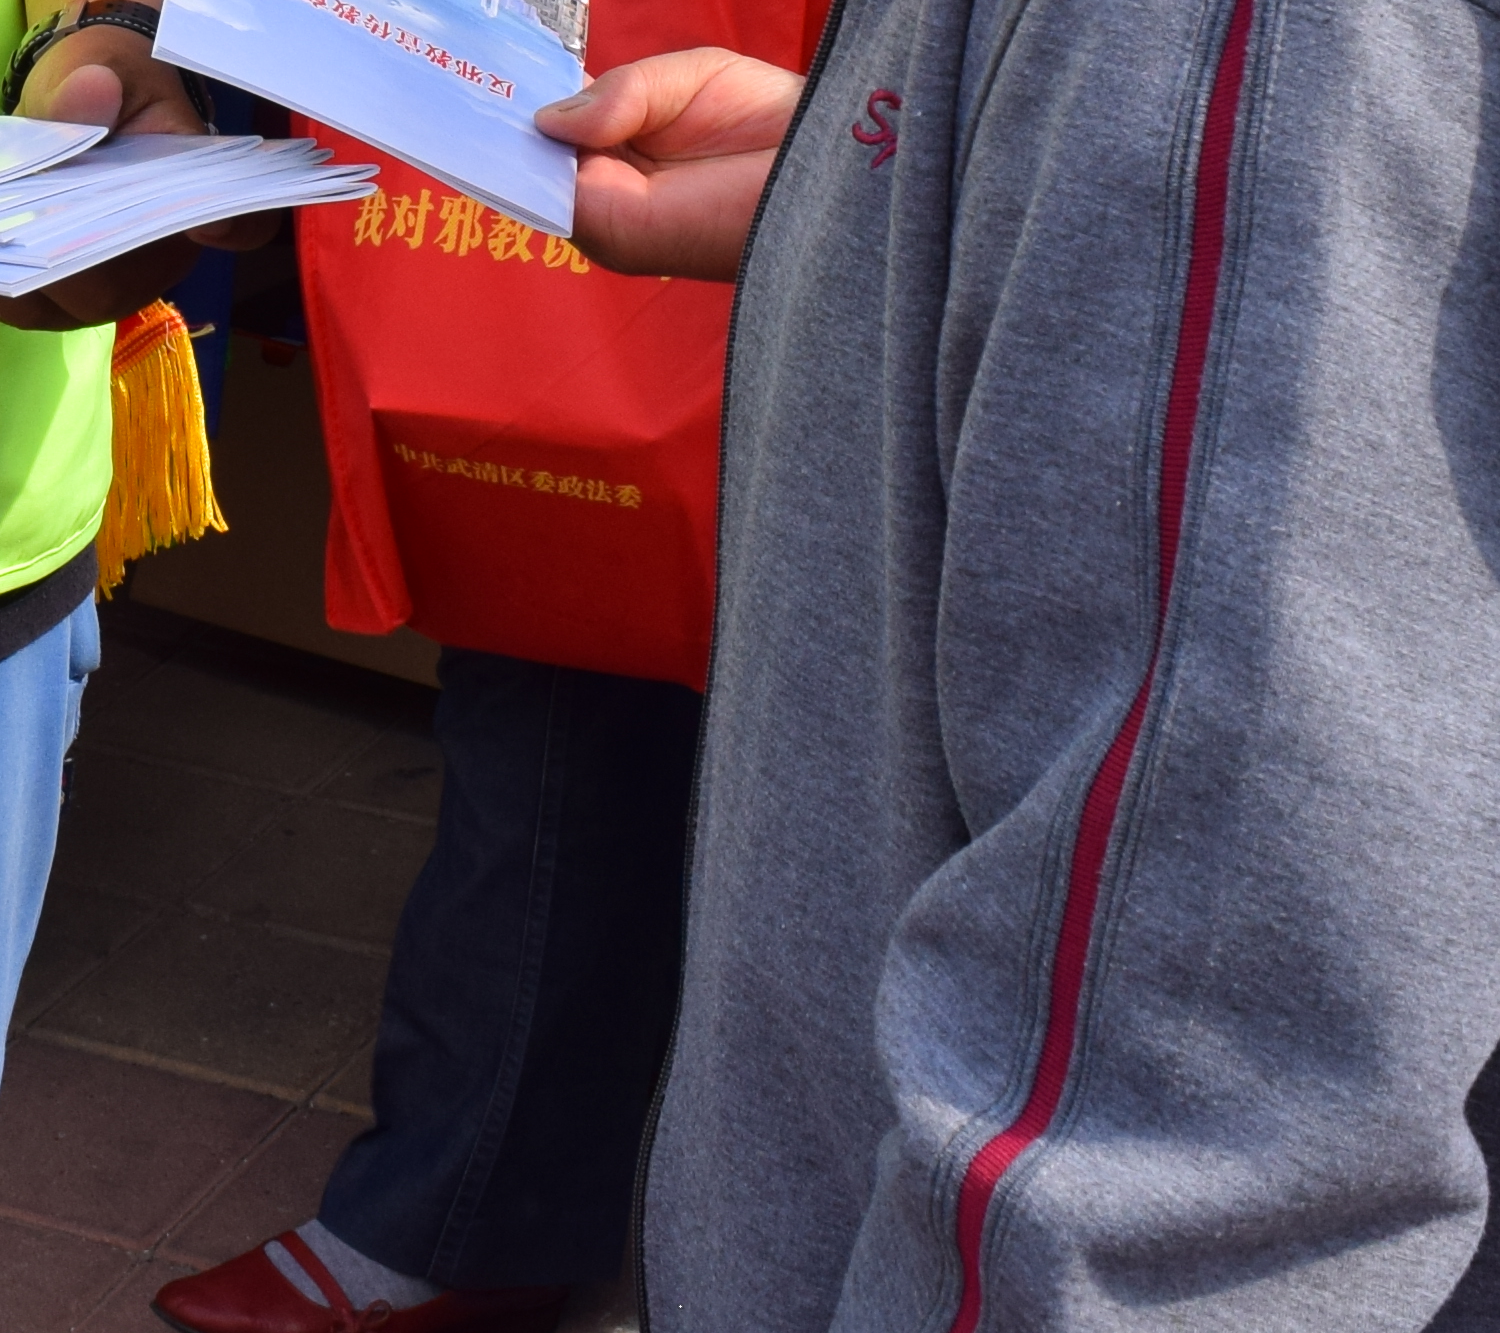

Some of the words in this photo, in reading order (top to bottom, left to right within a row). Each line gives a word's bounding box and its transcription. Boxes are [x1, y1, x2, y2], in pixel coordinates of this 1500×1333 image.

[393, 443, 644, 510] 中共武清区委政法委
